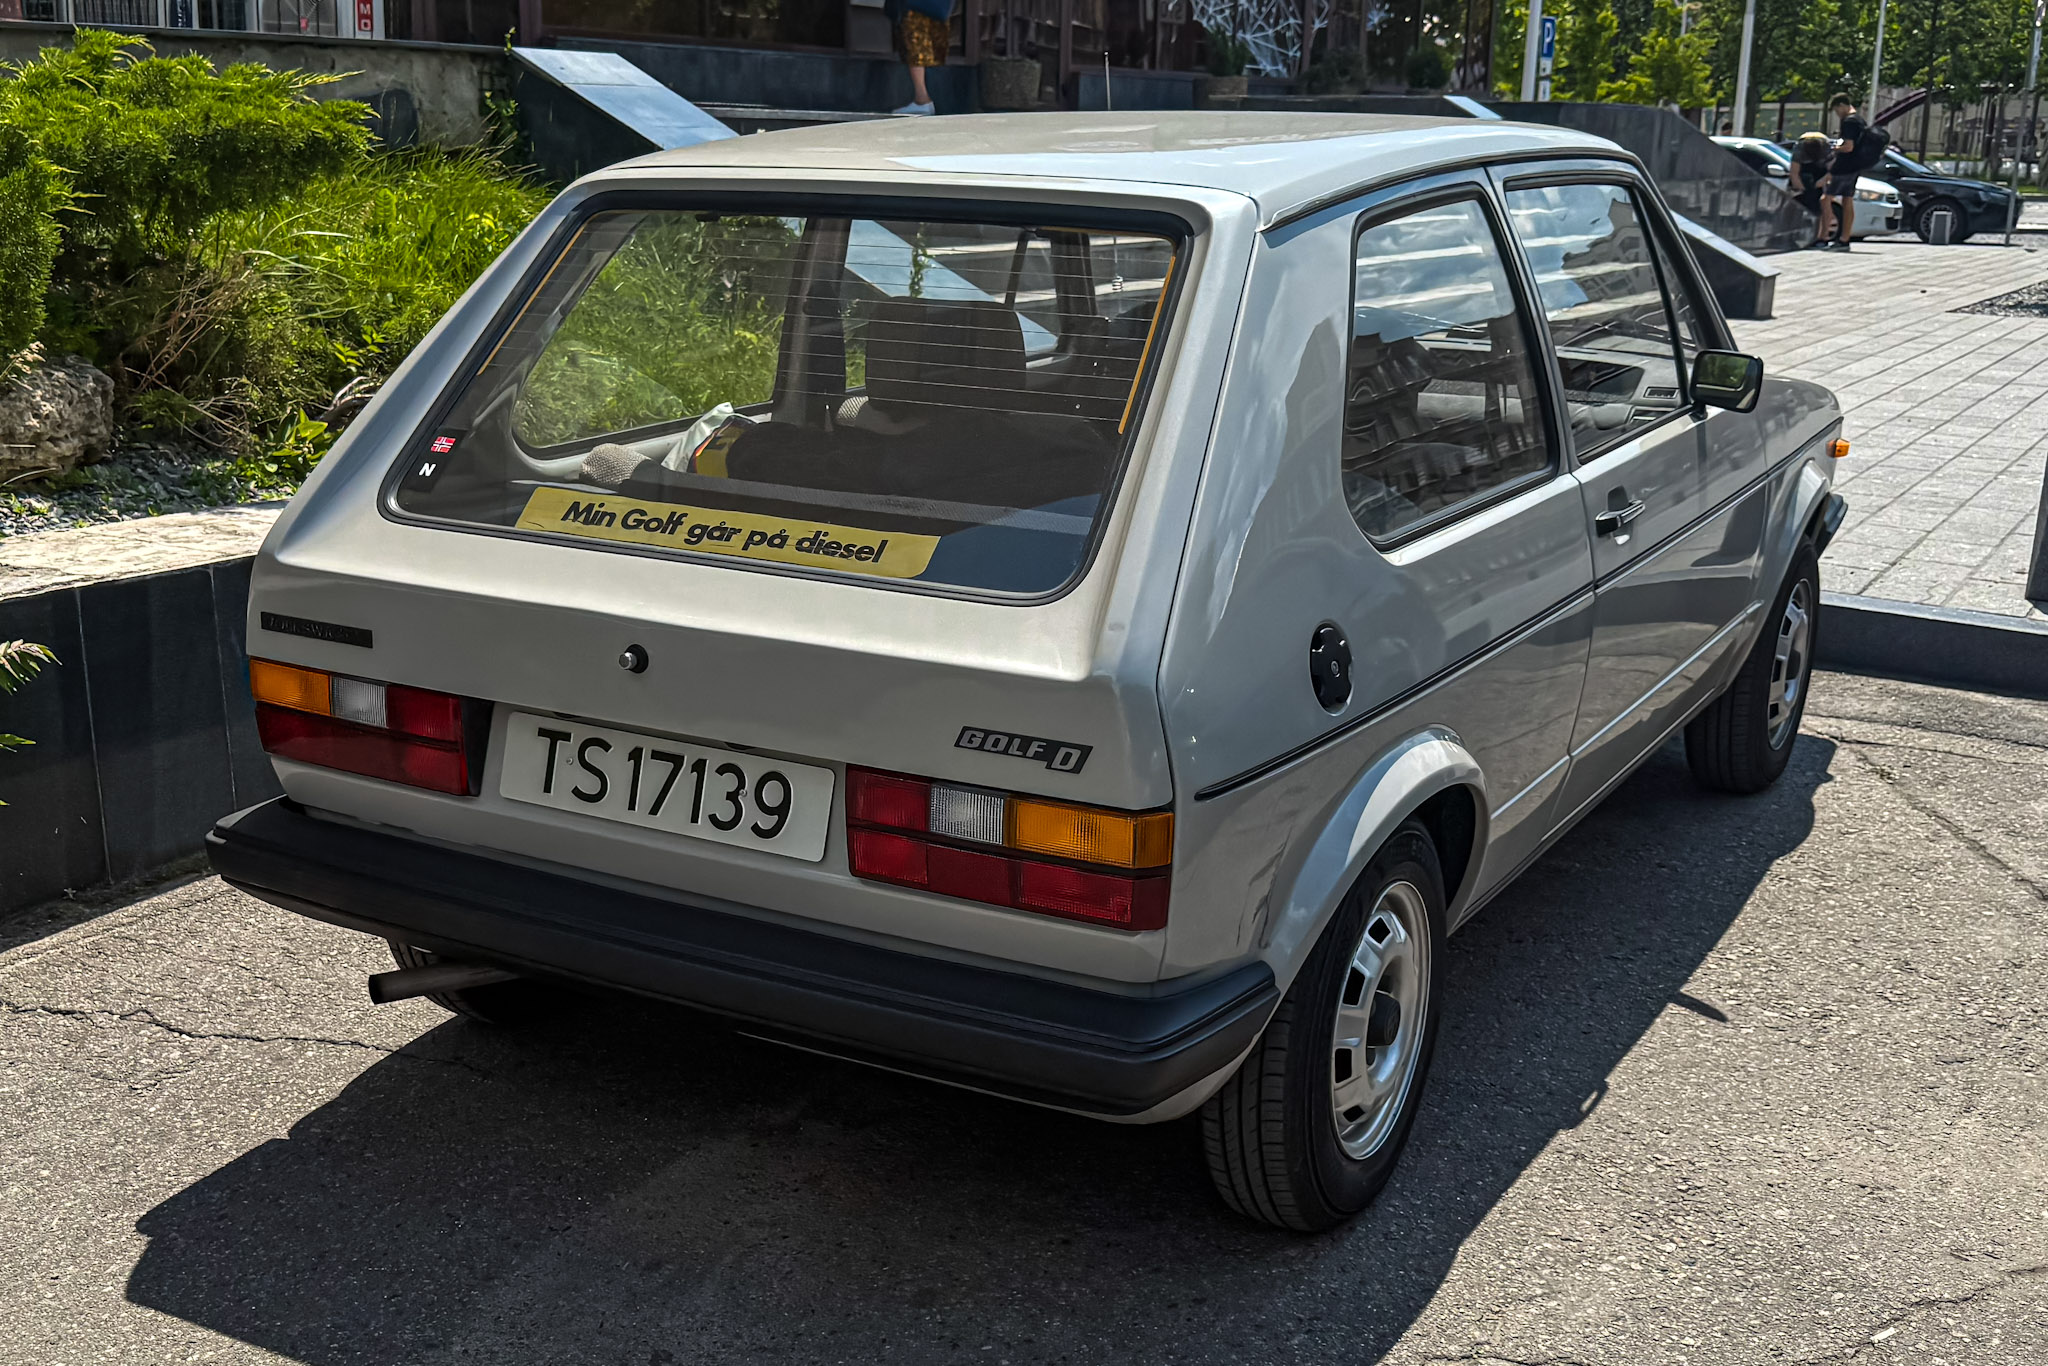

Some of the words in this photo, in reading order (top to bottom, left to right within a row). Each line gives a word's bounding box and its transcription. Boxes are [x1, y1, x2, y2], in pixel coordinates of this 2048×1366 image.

[1543, 22, 1553, 54] P
[419, 462, 437, 477] N
[561, 501, 617, 527] Min
[621, 508, 688, 536] Golf
[683, 521, 742, 546] går
[741, 529, 790, 552] på
[795, 530, 889, 563] diesel
[959, 730, 1047, 758] GOLF
[1050, 746, 1082, 771] D
